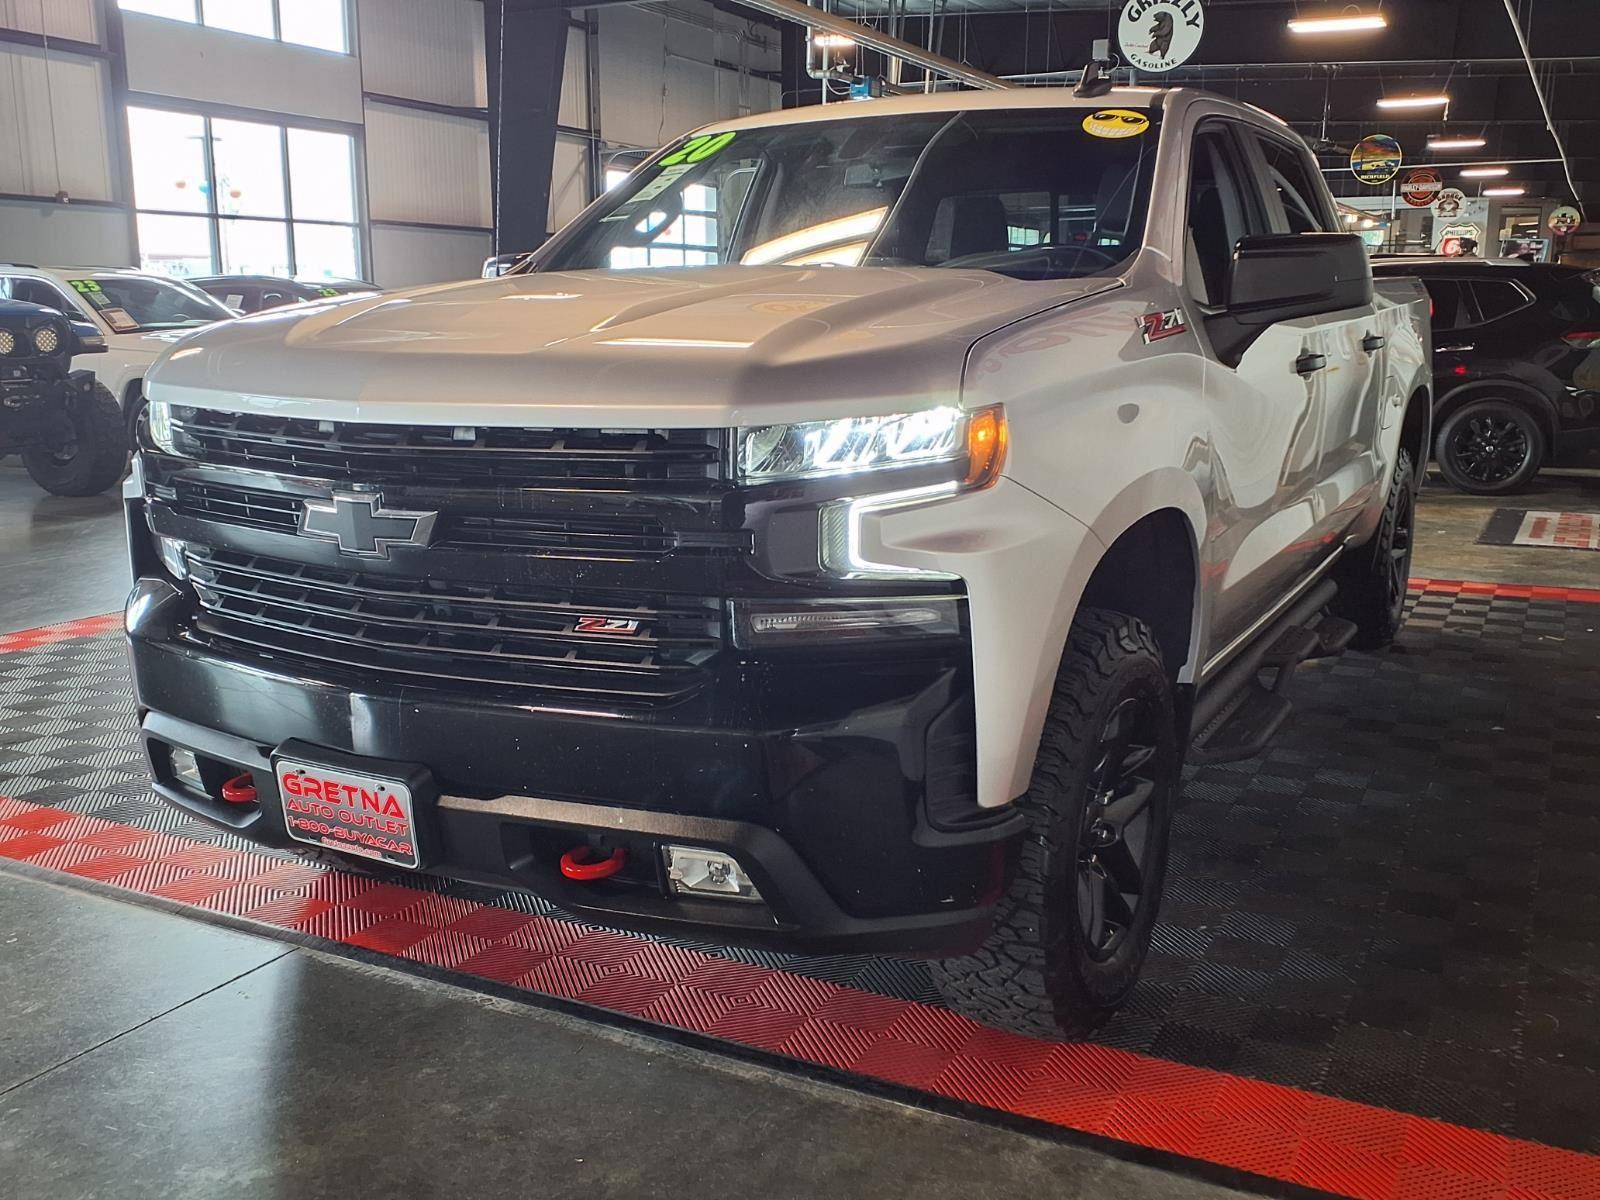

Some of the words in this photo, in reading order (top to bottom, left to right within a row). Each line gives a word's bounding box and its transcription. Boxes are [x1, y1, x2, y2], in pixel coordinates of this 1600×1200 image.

[1128, 0, 1200, 28] GRLY
[1130, 53, 1177, 69] GASOLINE
[658, 132, 737, 167] 20
[70, 280, 102, 293] 23
[1135, 308, 1187, 345] Z71
[574, 616, 640, 635] Z71
[282, 773, 405, 819] GRETNA
[287, 798, 334, 819] AUTO
[338, 809, 409, 836] OUTLET
[287, 815, 413, 856] 1-800-BUYACAR
